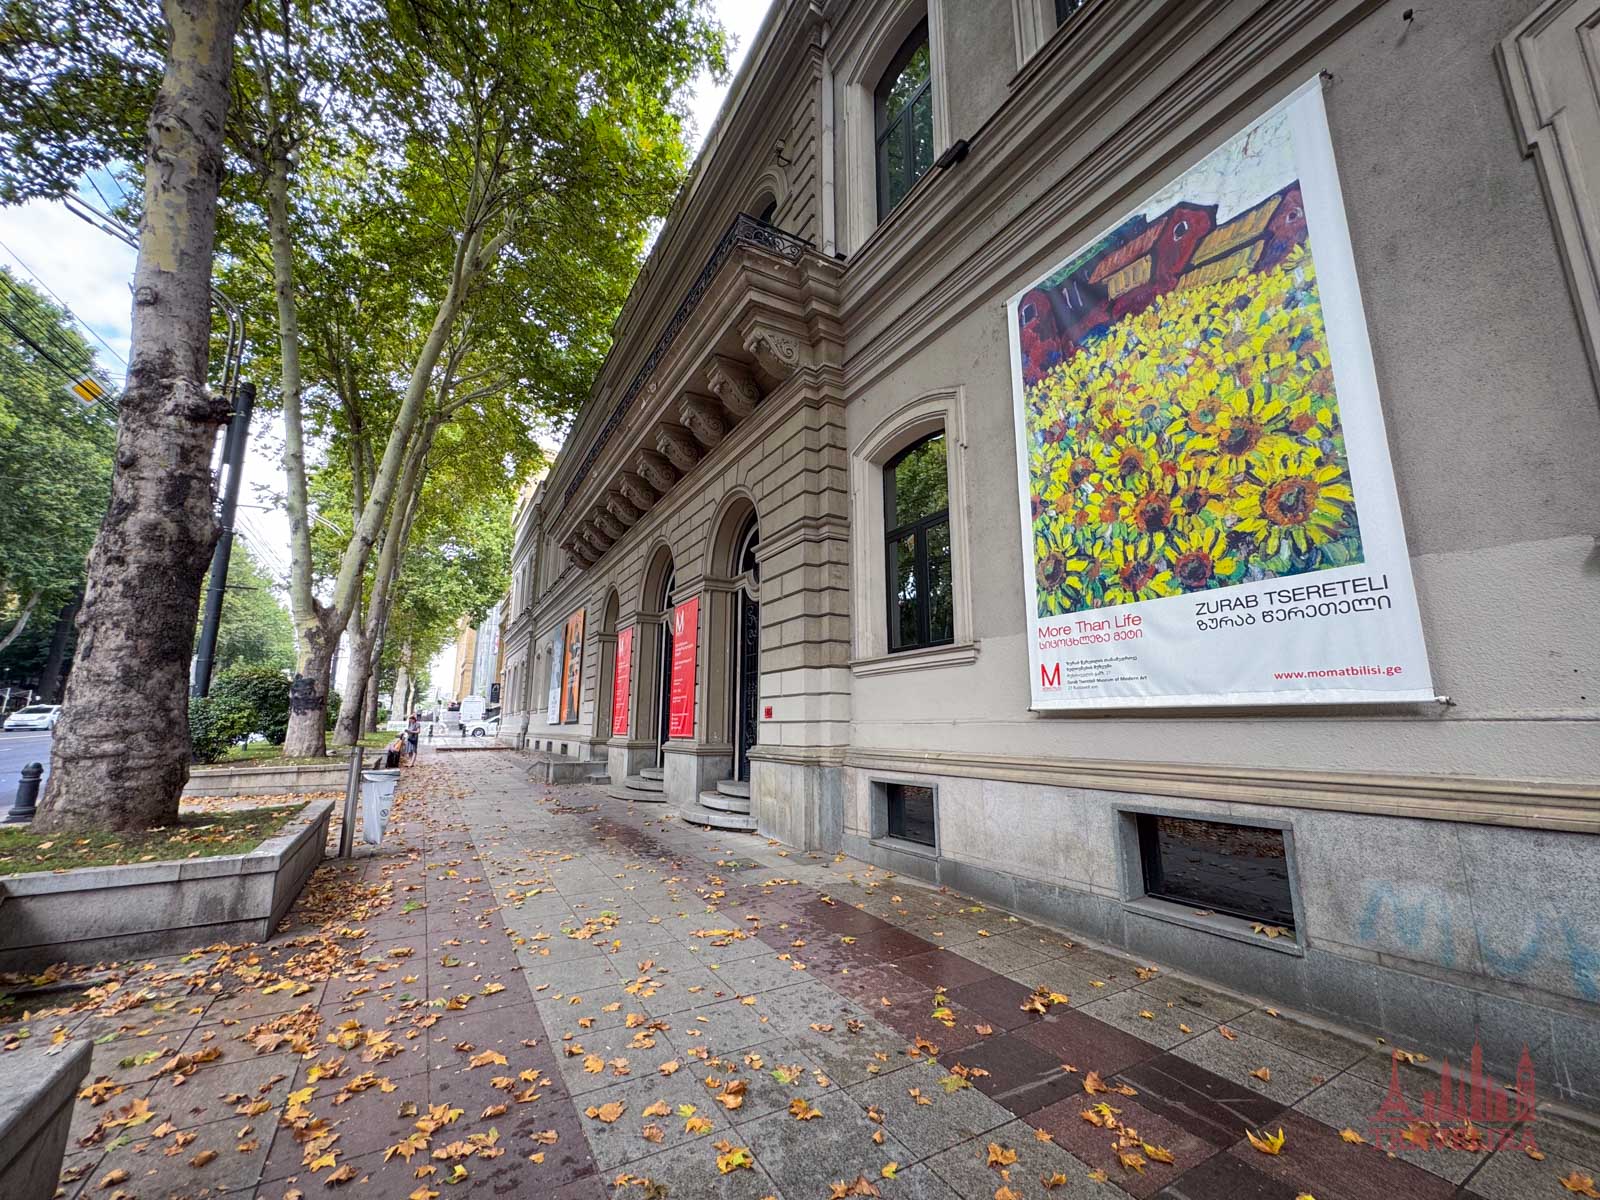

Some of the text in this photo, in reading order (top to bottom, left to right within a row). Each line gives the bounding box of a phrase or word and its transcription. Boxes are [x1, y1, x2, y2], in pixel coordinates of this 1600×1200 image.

[1195, 574, 1389, 616] ZURAB TSERETELI
[1196, 595, 1391, 631] ზურაბ წერეთელი
[1038, 613, 1142, 639] More Than Life
[1039, 628, 1143, 650] სიცოცხლეზე მეტი
[1040, 662, 1061, 687] M
[1274, 665, 1402, 680] www.momatbilisi.ge
